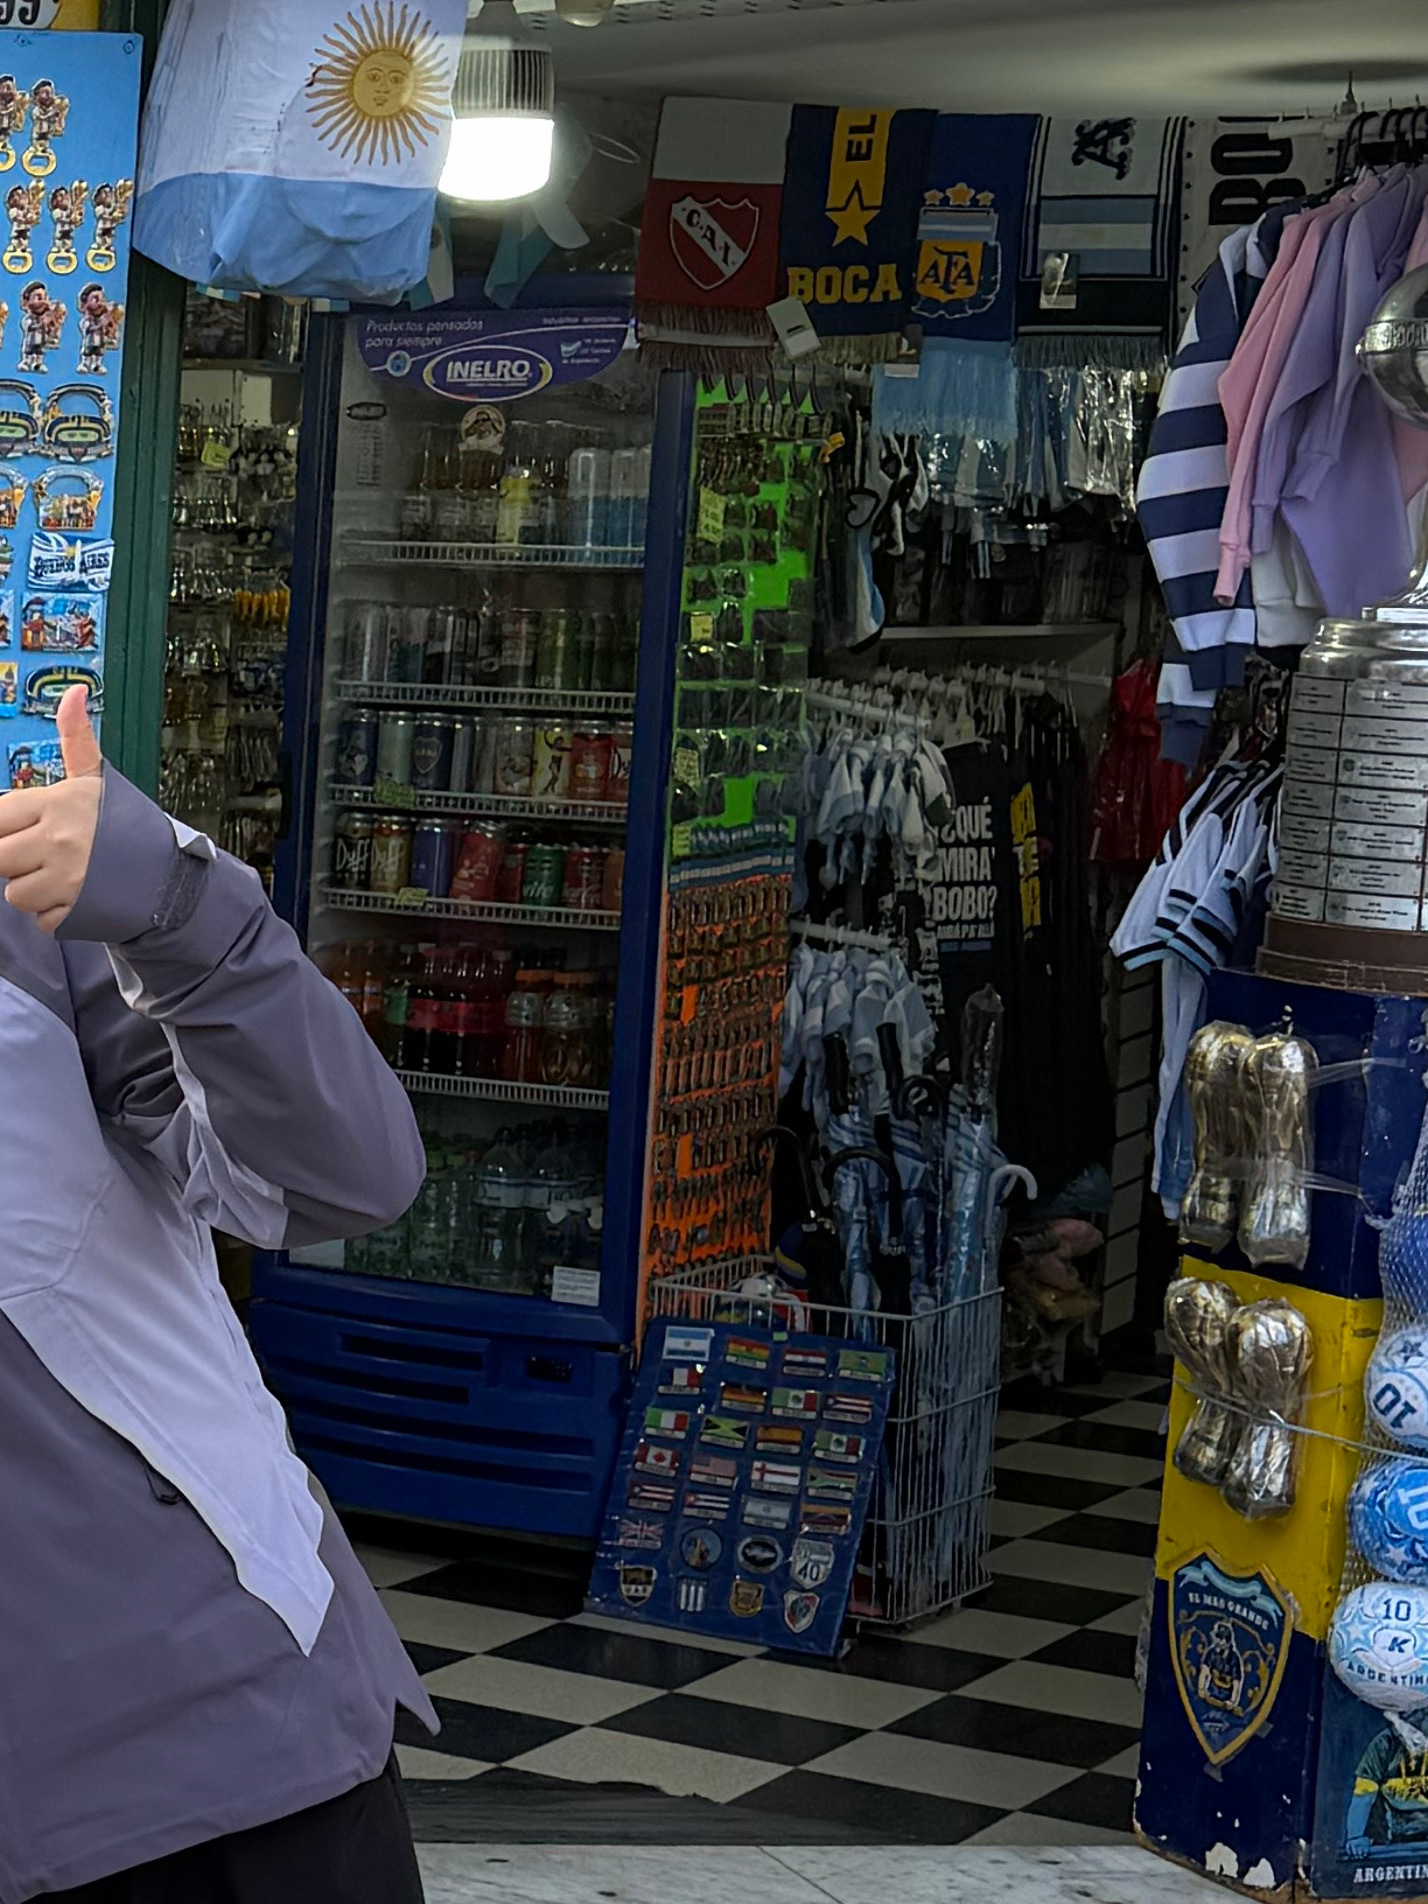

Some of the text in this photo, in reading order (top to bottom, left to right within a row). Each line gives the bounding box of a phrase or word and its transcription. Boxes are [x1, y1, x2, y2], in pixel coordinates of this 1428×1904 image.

[787, 263, 903, 305] BOCA
[446, 359, 530, 380] INELRO
[932, 884, 998, 922] BOBO?
[798, 1562, 822, 1582] 40
[1188, 1592, 1202, 1605] EL
[1226, 1600, 1271, 1631] GRANDE
[1383, 1598, 1412, 1621] 10
